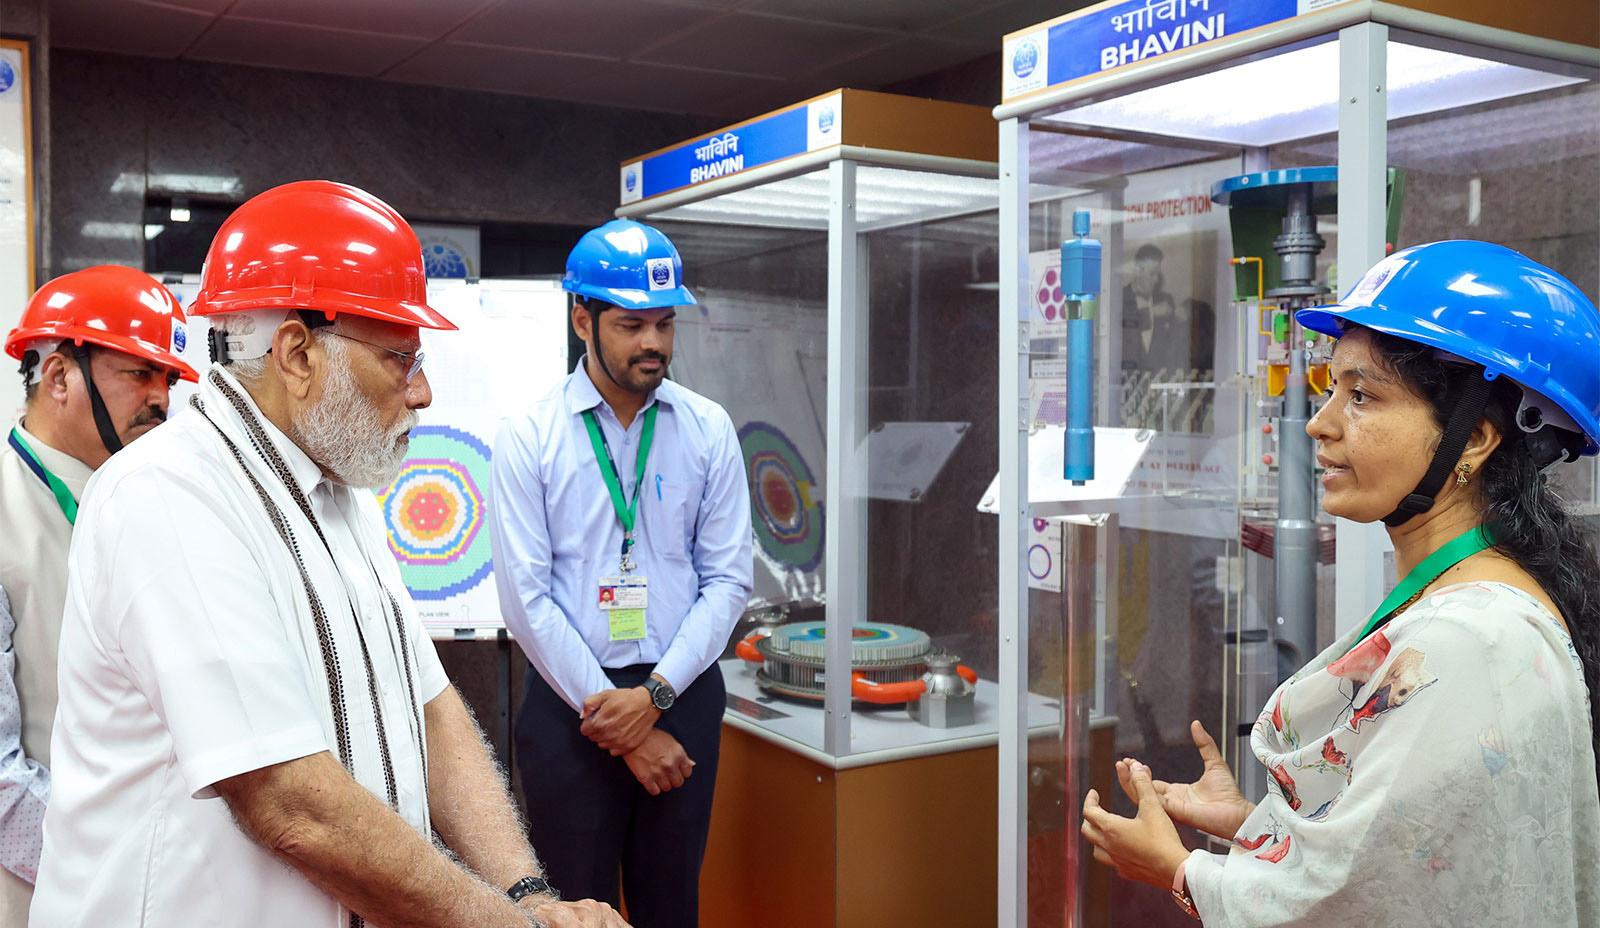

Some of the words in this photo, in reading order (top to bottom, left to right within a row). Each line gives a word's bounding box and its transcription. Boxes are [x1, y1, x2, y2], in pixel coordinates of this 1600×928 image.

[1100, 12, 1225, 71] BHAVINI
[694, 132, 740, 162] भाविनि
[689, 153, 744, 185] BHAVINI
[1146, 195, 1213, 221] PROTECTION
